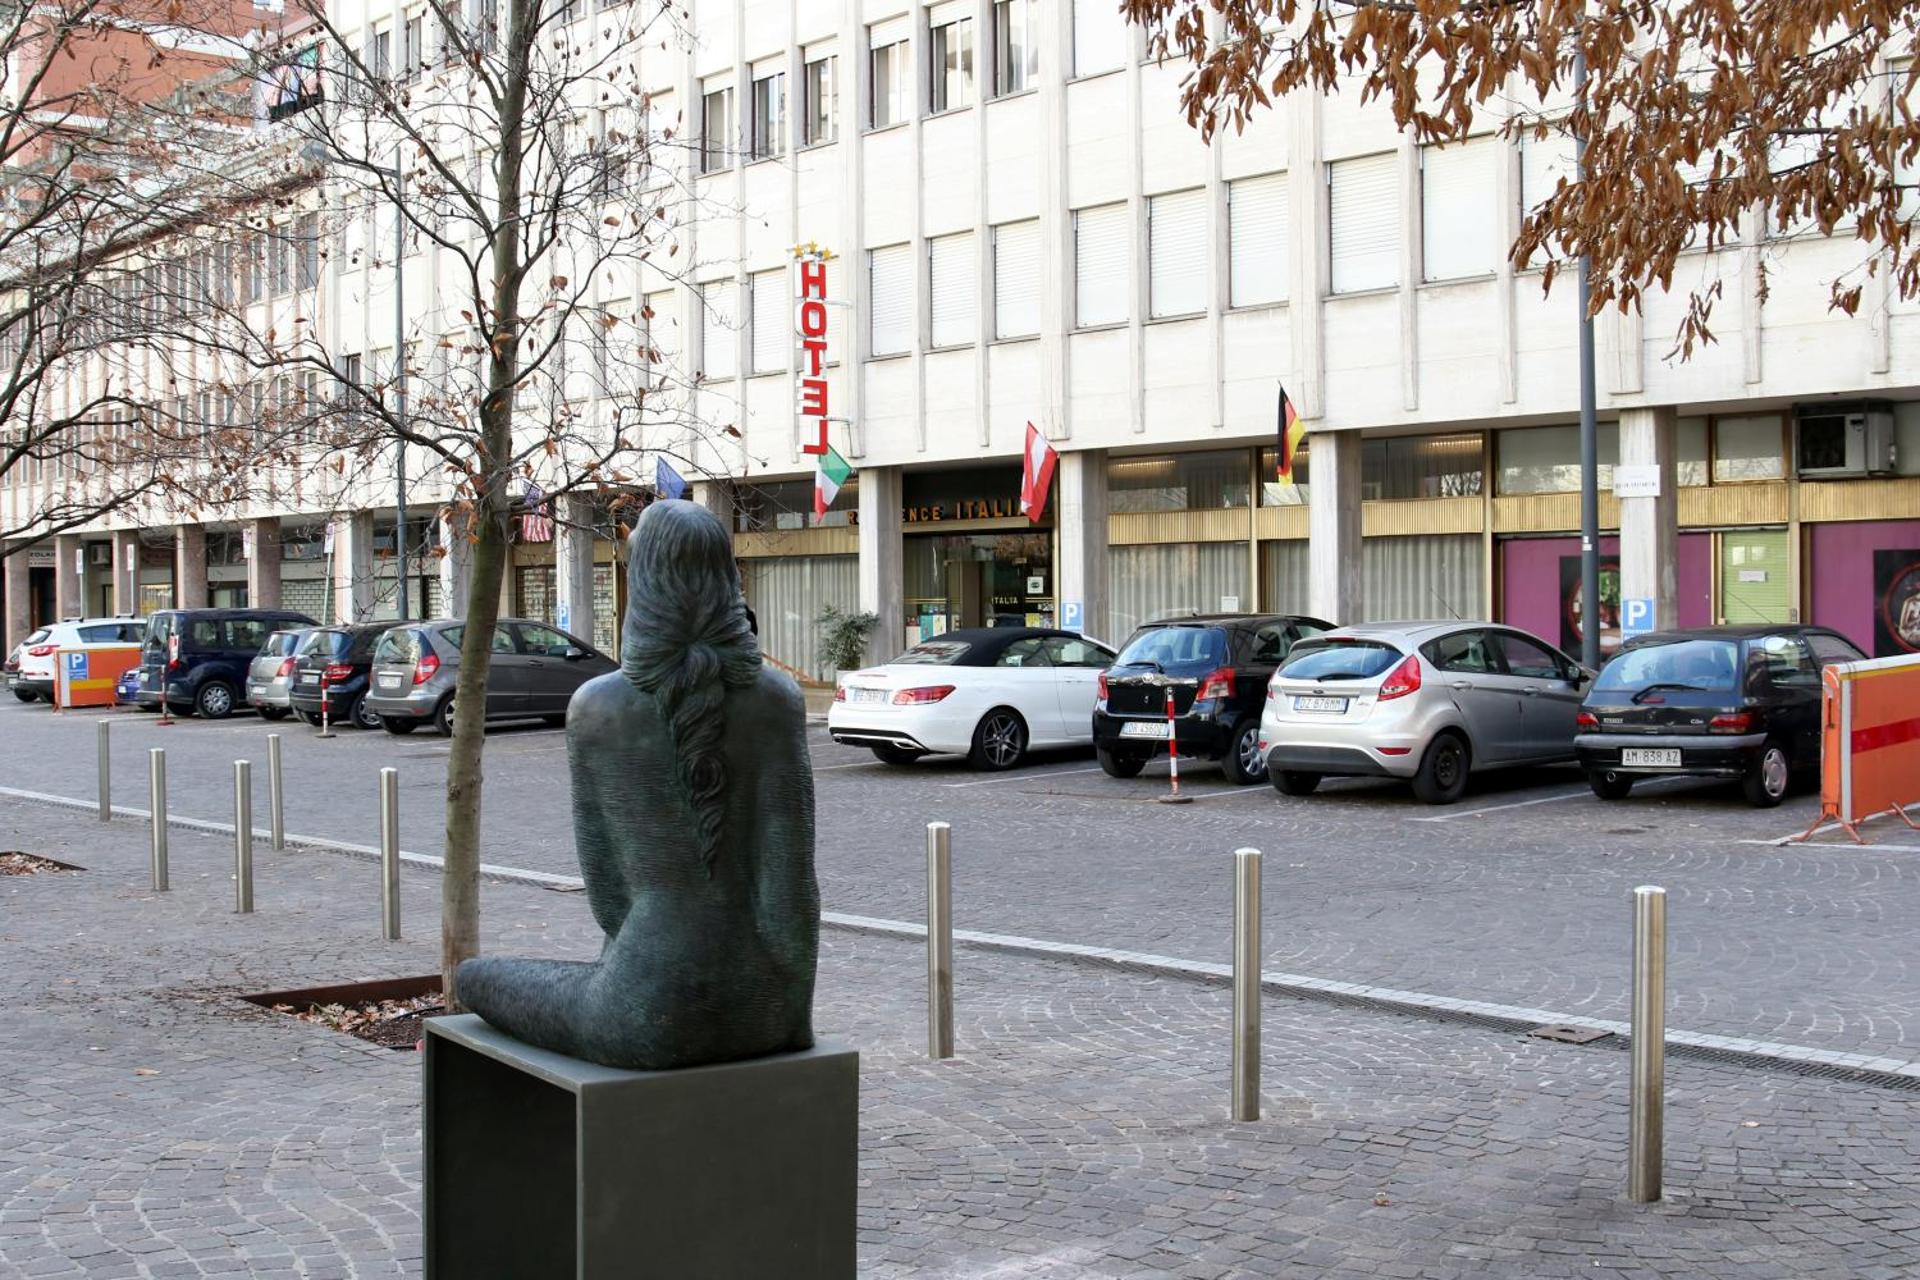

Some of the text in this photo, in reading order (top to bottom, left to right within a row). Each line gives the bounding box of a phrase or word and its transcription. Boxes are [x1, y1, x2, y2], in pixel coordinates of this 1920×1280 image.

[847, 506, 941, 524] RENCE
[991, 597, 1018, 605] ITALIA
[1066, 604, 1078, 625] P
[1628, 601, 1647, 626] P
[71, 654, 84, 668] P
[1625, 750, 1679, 763] AM 838 AZ
